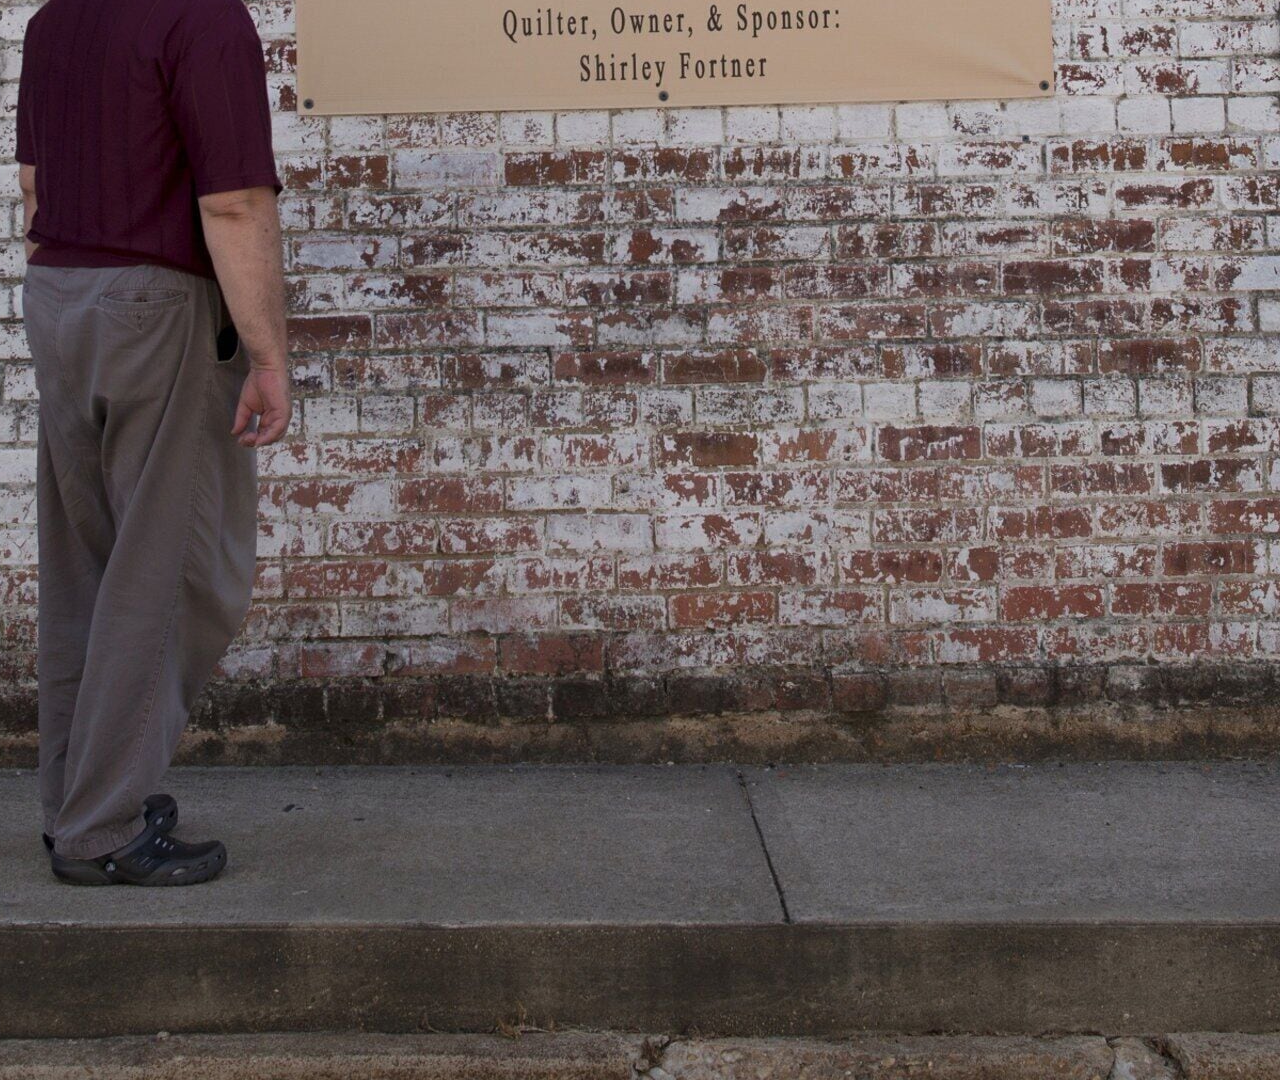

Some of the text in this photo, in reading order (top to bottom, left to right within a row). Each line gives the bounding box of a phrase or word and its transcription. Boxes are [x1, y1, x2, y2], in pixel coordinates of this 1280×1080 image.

[502, 3, 840, 44] Quilter, Owner, & Sponsor:
[579, 52, 767, 88] Shirley Fortner
